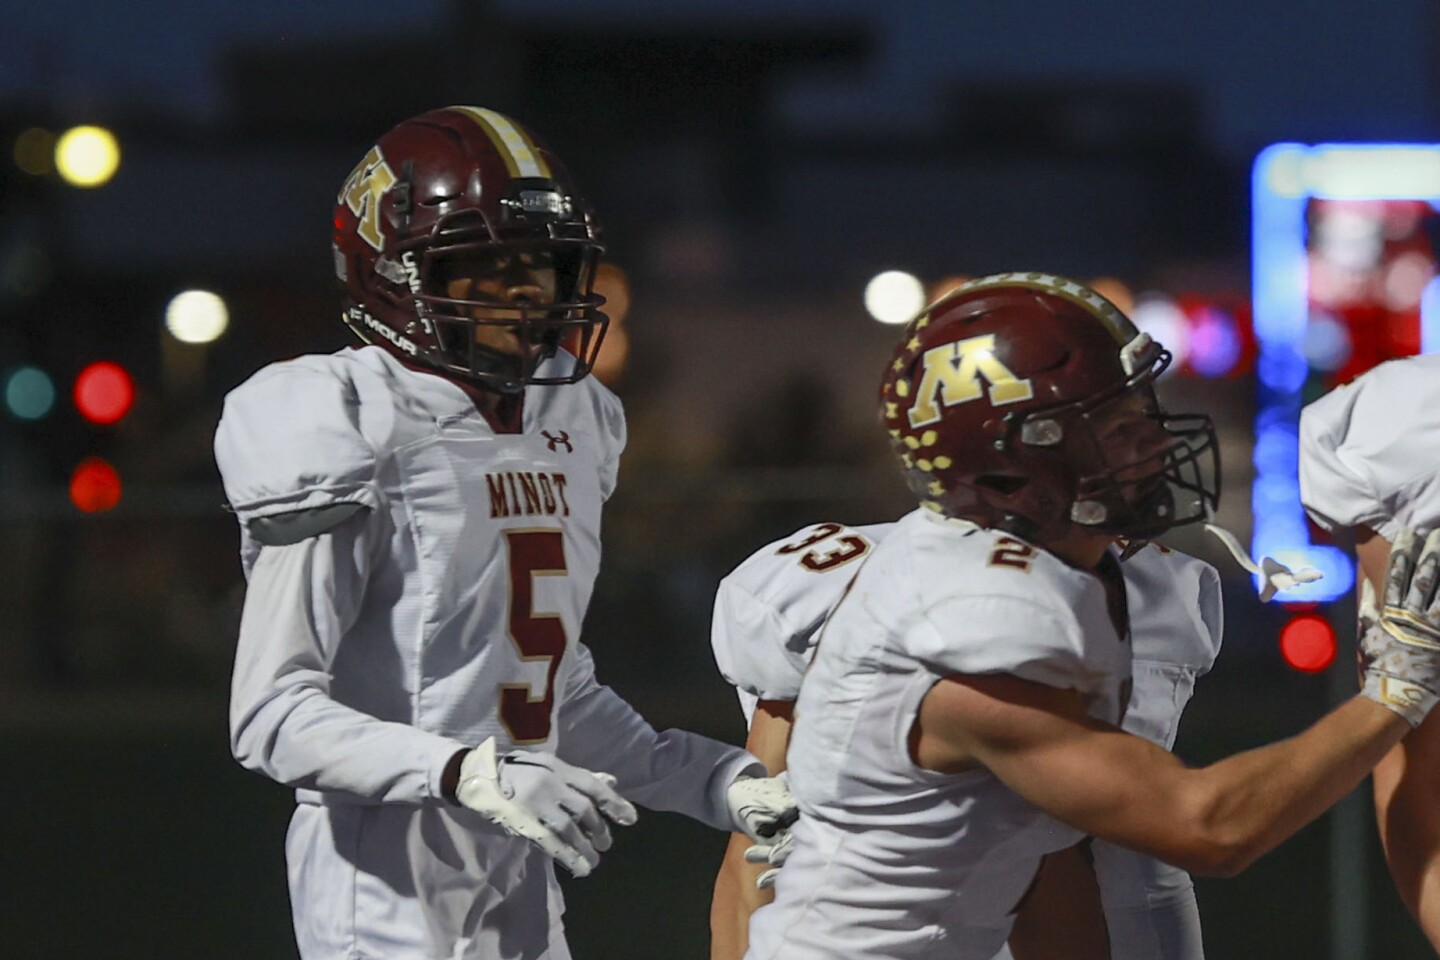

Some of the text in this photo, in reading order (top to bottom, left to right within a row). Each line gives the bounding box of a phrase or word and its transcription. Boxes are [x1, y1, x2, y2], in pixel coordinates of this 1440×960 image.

[908, 333, 1034, 429] M
[485, 471, 571, 520] MINOT
[774, 522, 871, 574] 33
[986, 536, 1036, 575] 2
[498, 526, 571, 745] 5
